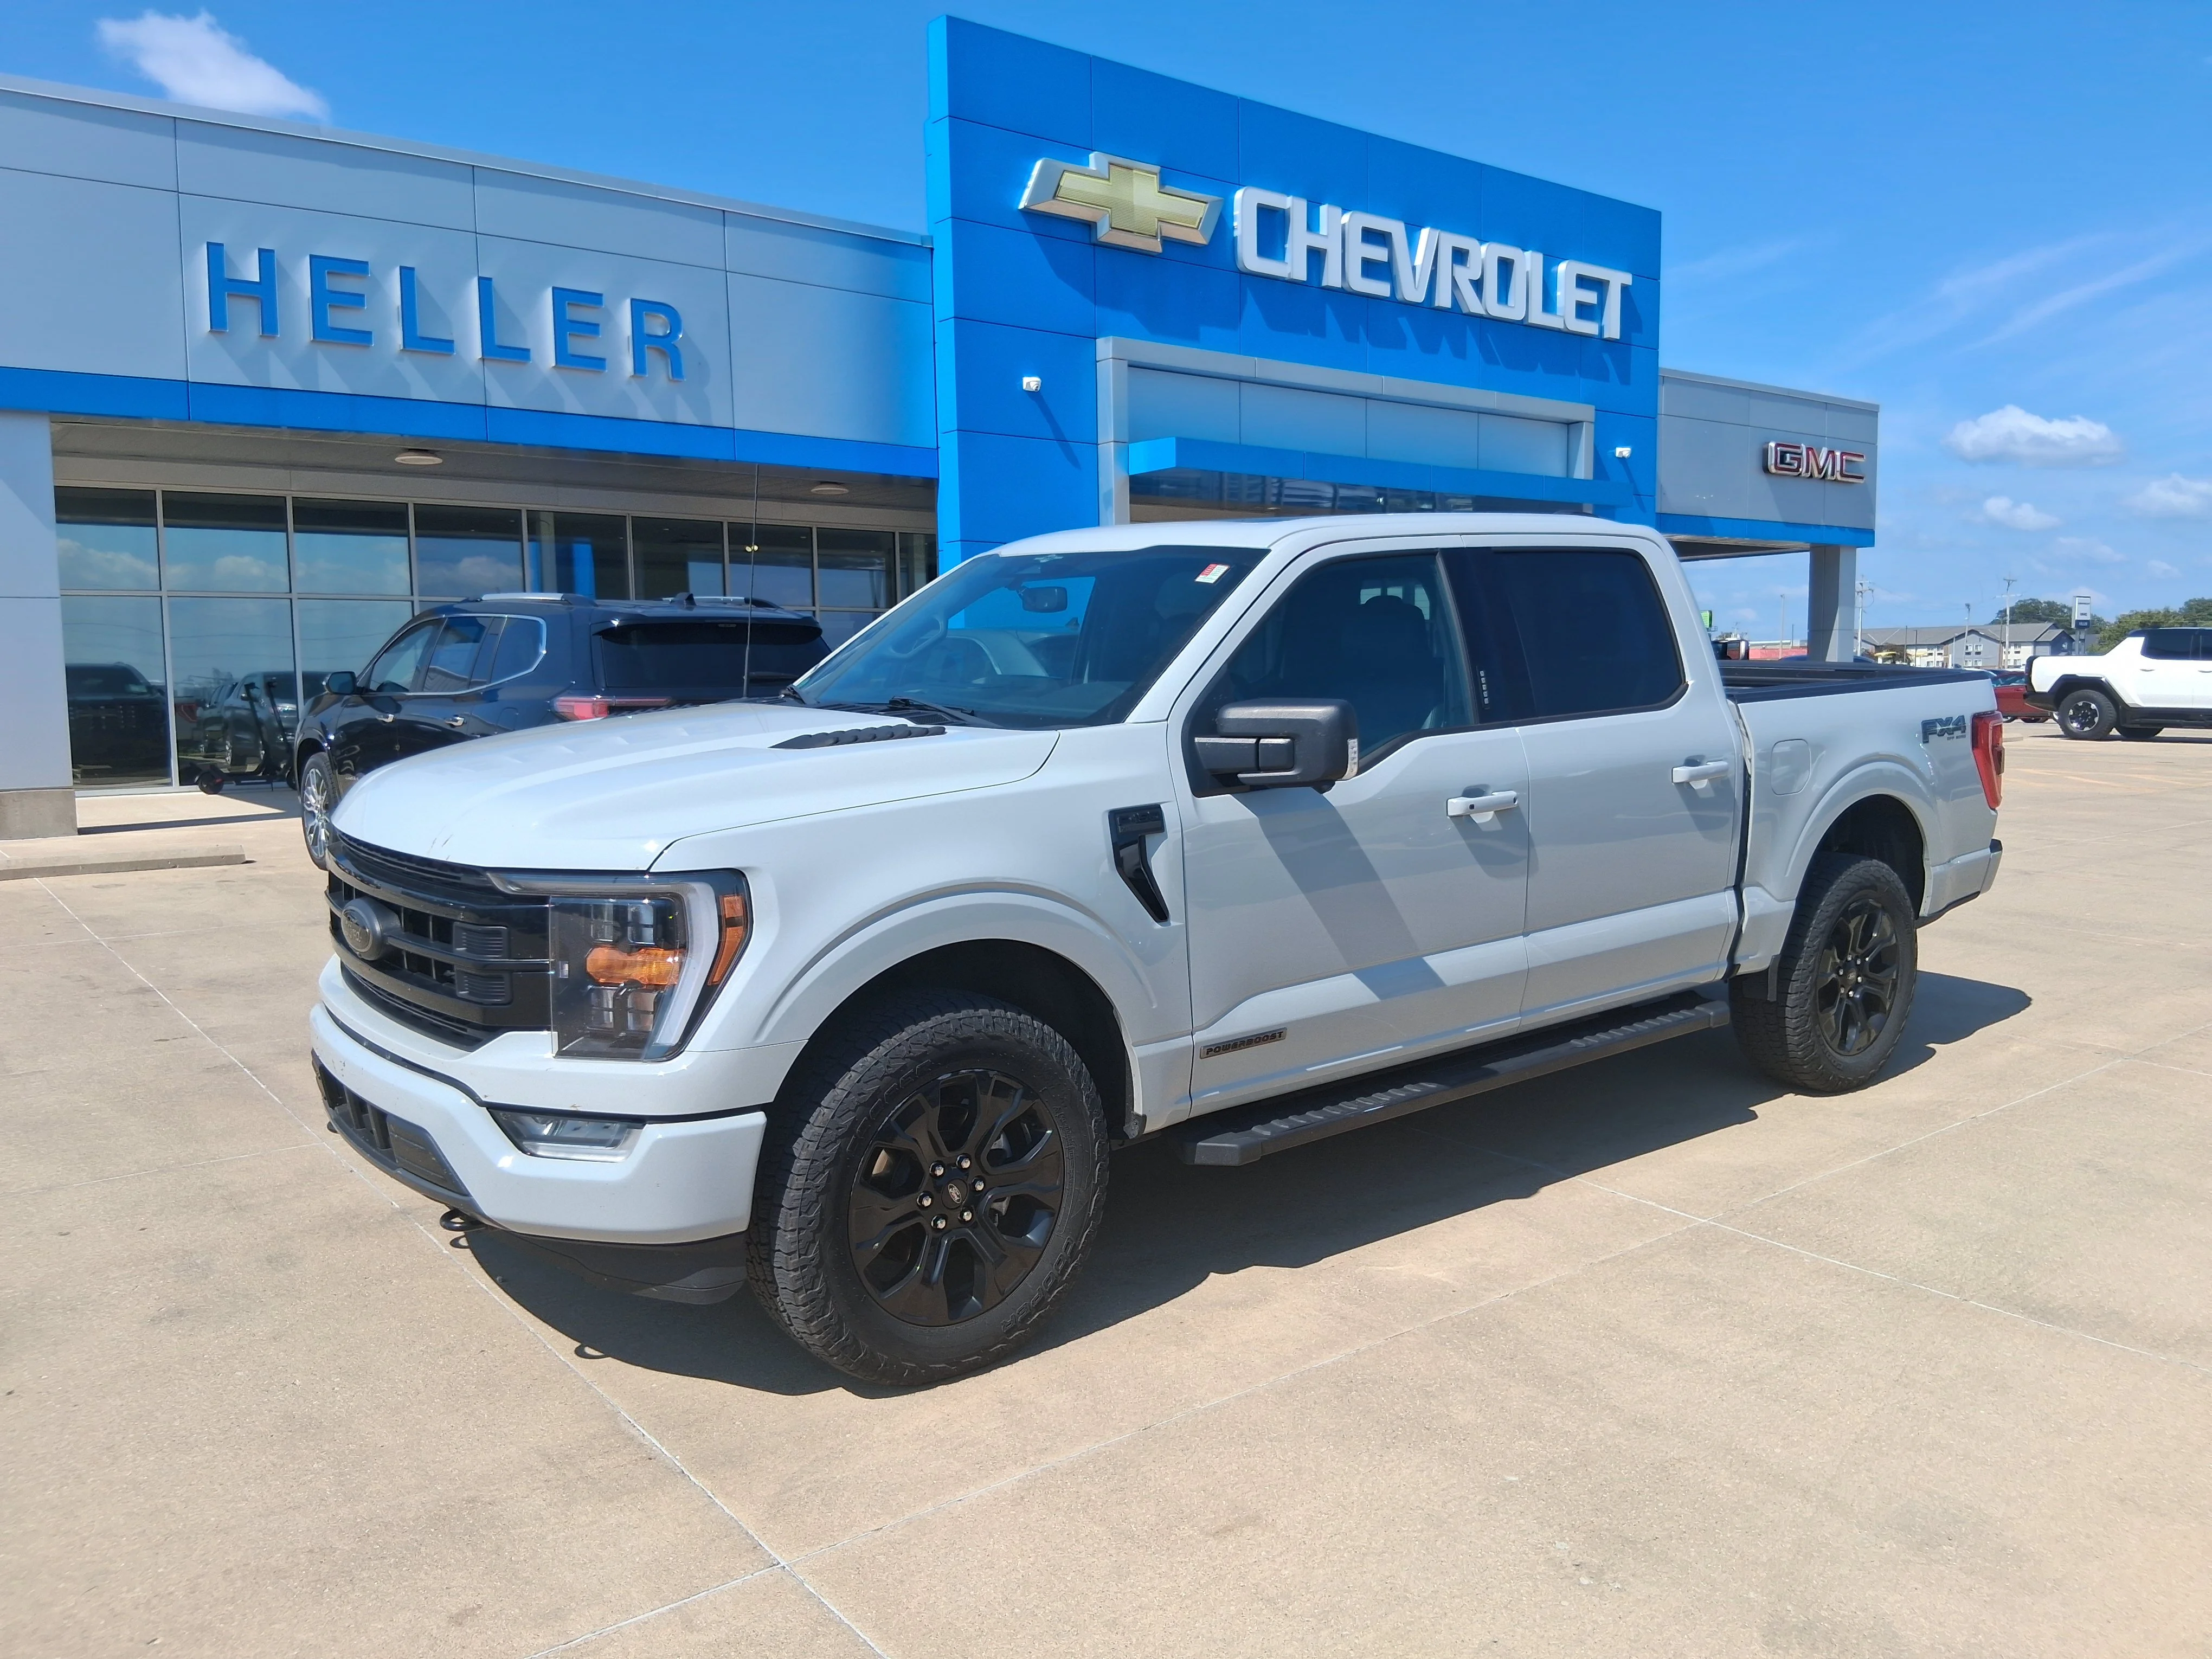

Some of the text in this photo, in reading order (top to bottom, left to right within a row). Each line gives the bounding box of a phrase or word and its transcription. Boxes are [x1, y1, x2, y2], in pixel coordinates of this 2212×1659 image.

[1233, 186, 1632, 339] CHEVROLET
[206, 241, 686, 382] HELLER
[1766, 441, 1866, 484] GMC
[1921, 715, 1966, 744] FX4
[1205, 1031, 1285, 1056] POWERBOOST
[1001, 1236, 1076, 1333] COOPER
